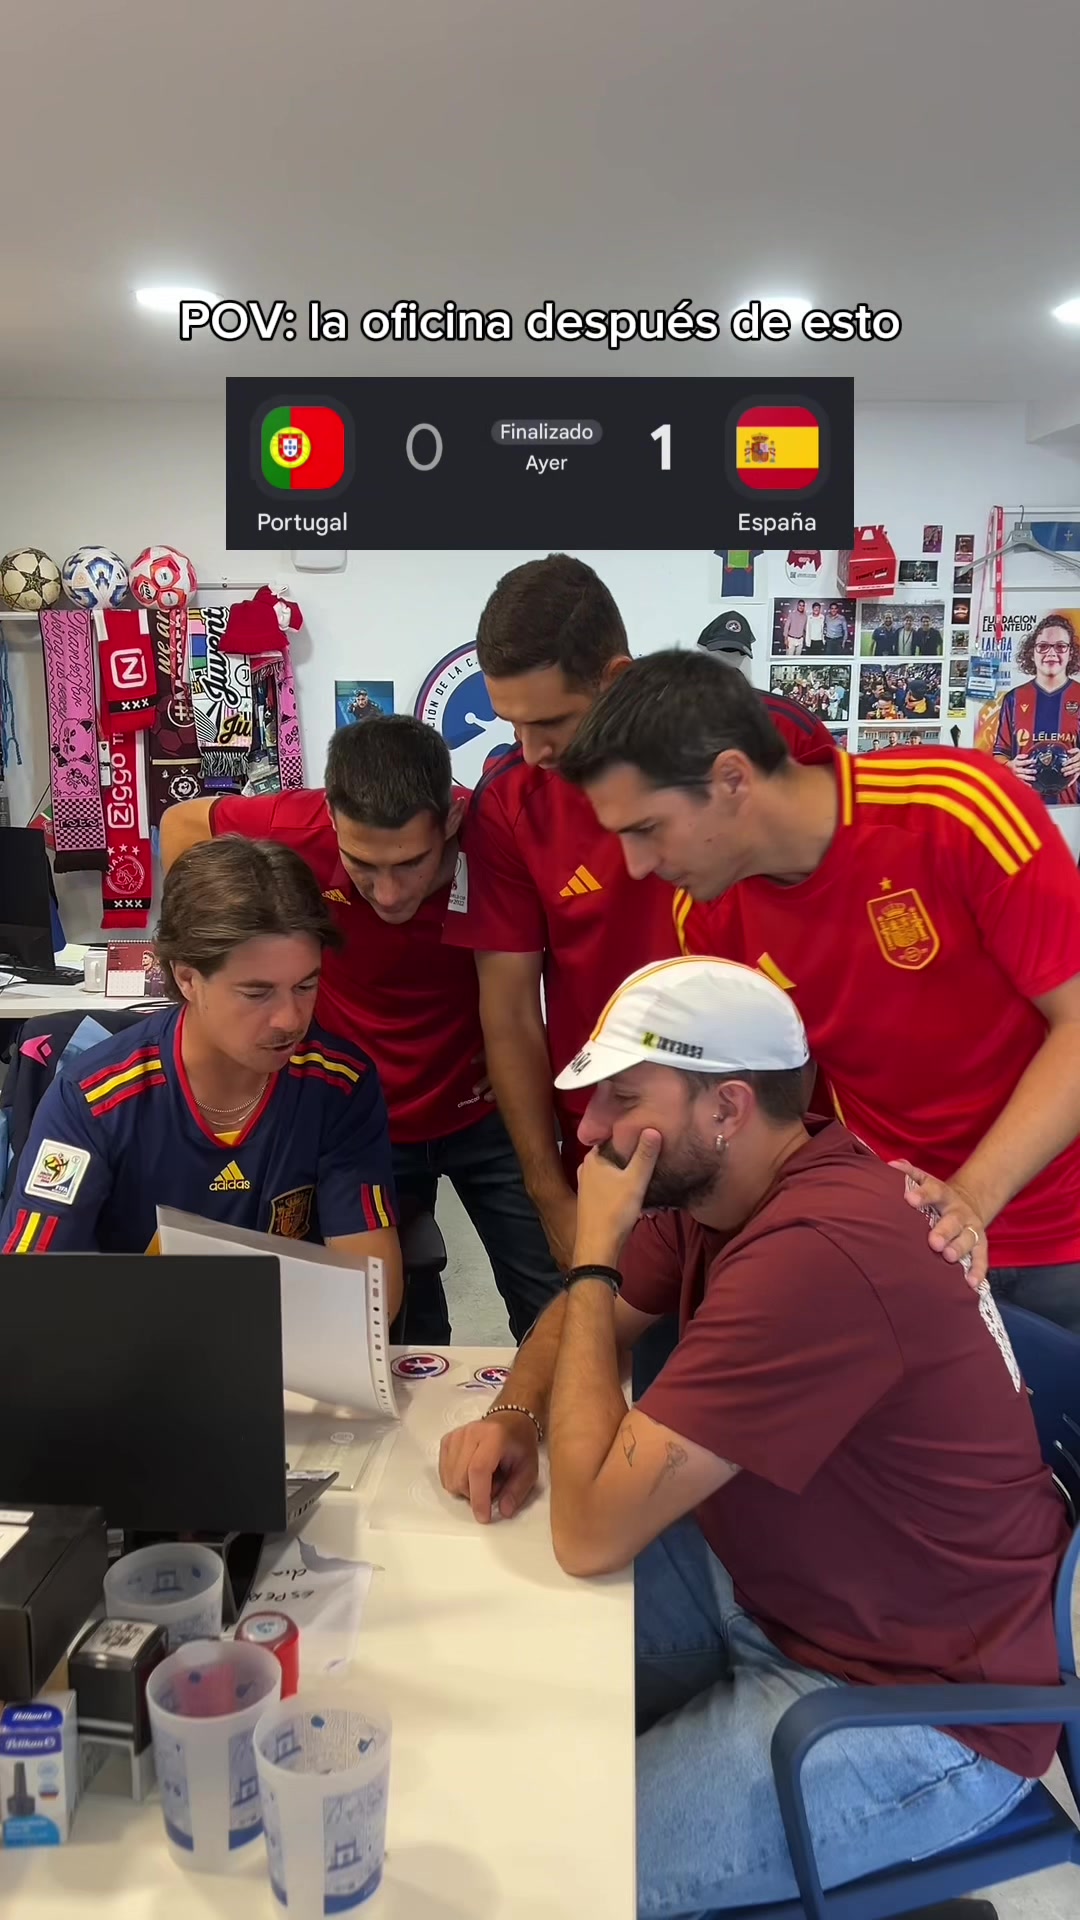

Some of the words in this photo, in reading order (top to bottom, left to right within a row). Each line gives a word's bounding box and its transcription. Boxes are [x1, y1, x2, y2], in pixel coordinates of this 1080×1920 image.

[983, 615, 1037, 624] FUDACION
[202, 607, 239, 706] Juvent
[435, 681, 449, 696] DE
[448, 666, 463, 680] LA
[208, 1179, 251, 1192] adidas
